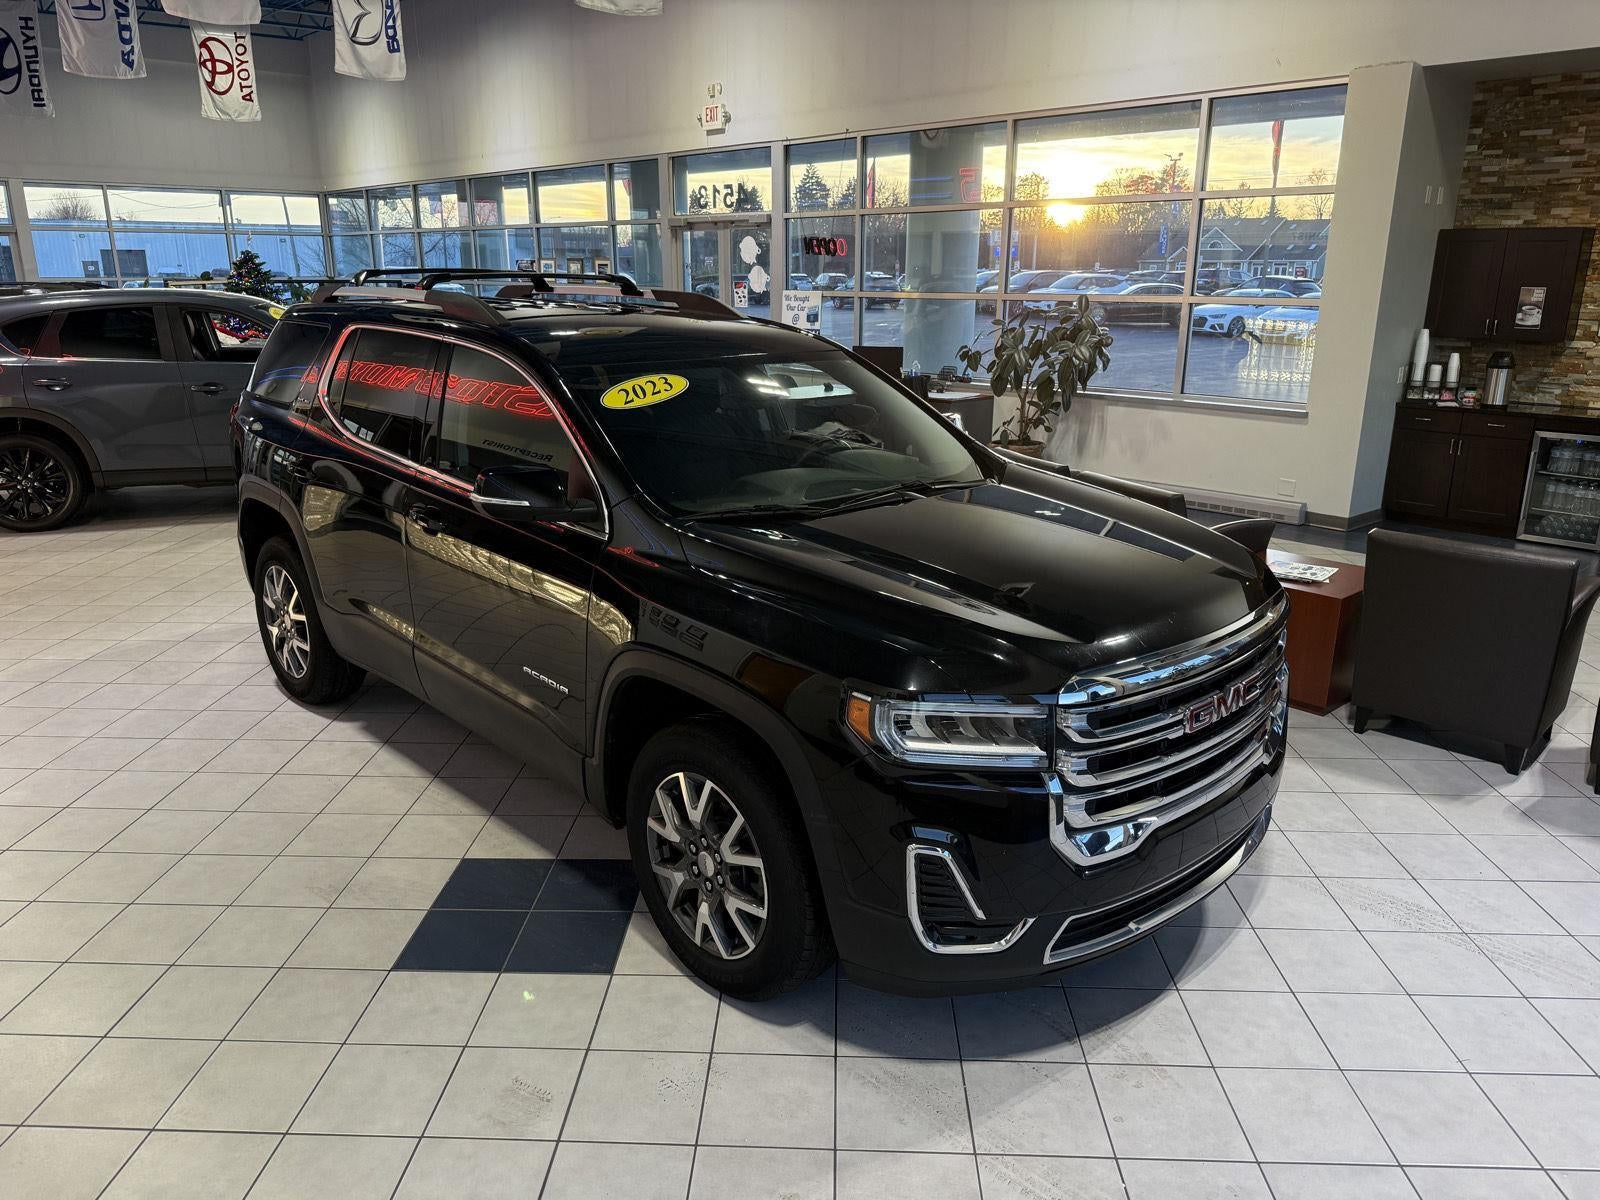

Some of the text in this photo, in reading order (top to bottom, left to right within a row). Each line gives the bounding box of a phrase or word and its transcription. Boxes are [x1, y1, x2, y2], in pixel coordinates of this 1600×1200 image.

[705, 106, 719, 123] EXIT
[784, 294, 810, 304] We Bought
[617, 376, 674, 406] 2023
[523, 666, 569, 694] ACADIA
[1184, 668, 1262, 733] GMC
